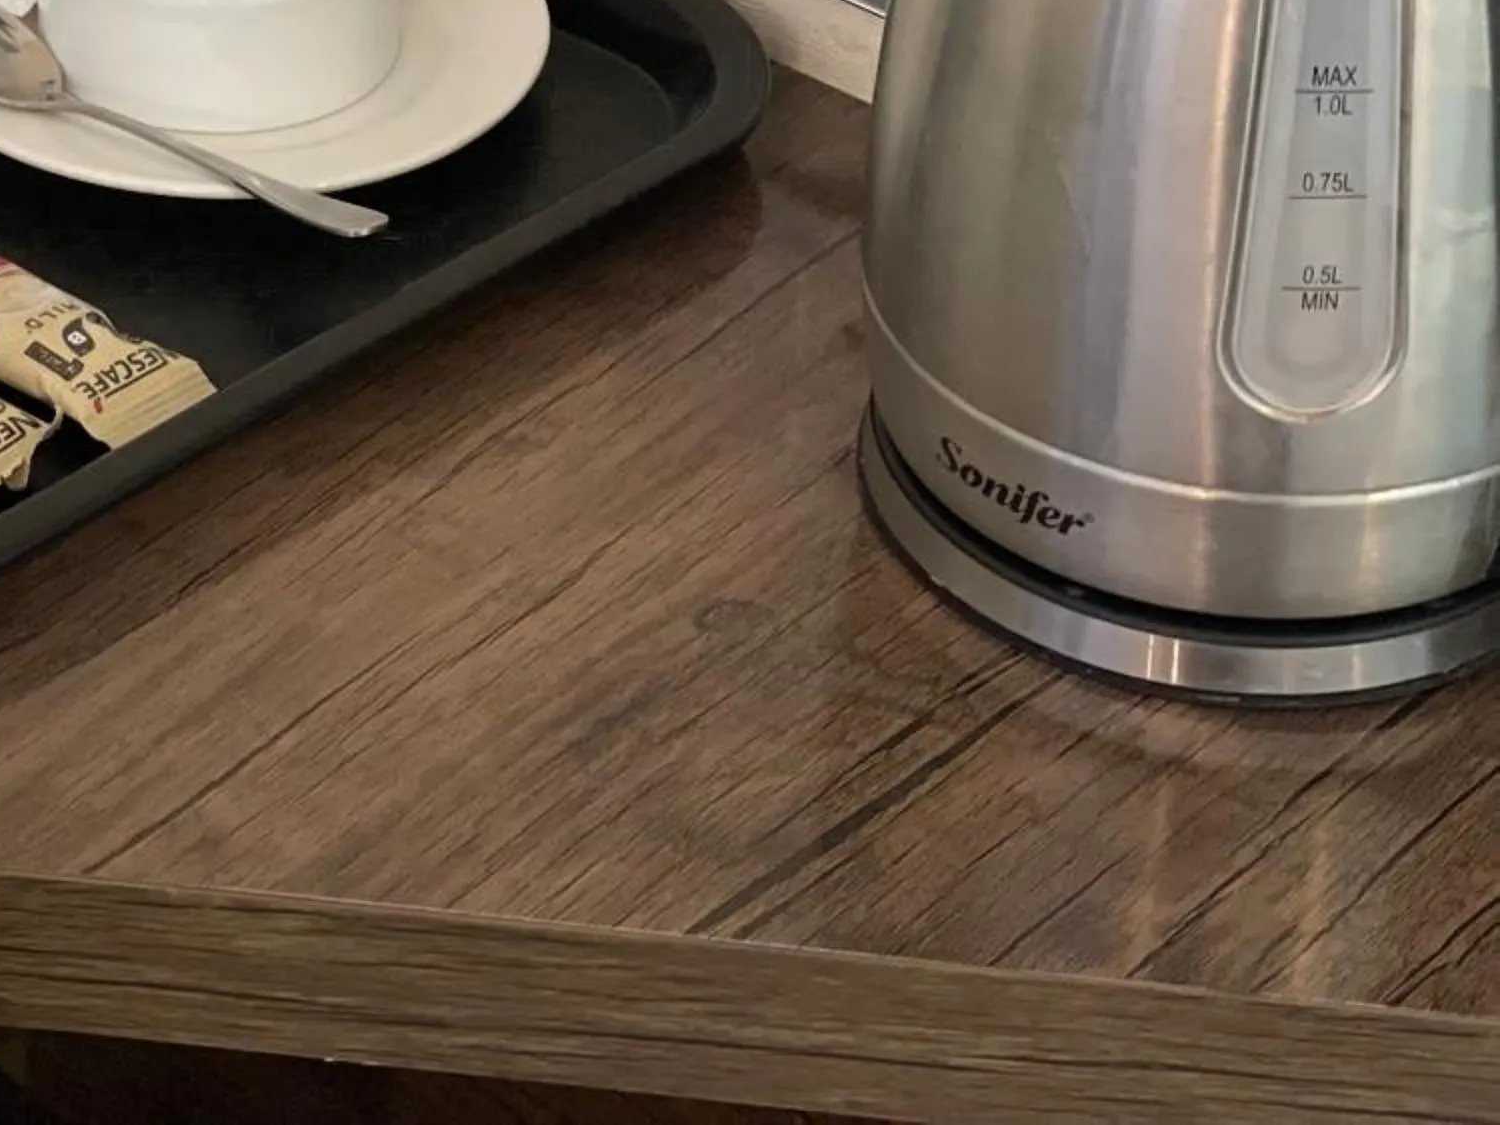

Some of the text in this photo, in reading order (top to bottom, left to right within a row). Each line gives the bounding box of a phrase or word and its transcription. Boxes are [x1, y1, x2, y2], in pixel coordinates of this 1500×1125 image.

[1311, 65, 1358, 87] MAX
[1313, 95, 1353, 116] 1.0L
[1302, 172, 1354, 193] 0.75L
[1302, 265, 1343, 285] 0.5L
[1300, 292, 1339, 311] MIN
[935, 436, 1088, 535] Sonifer
